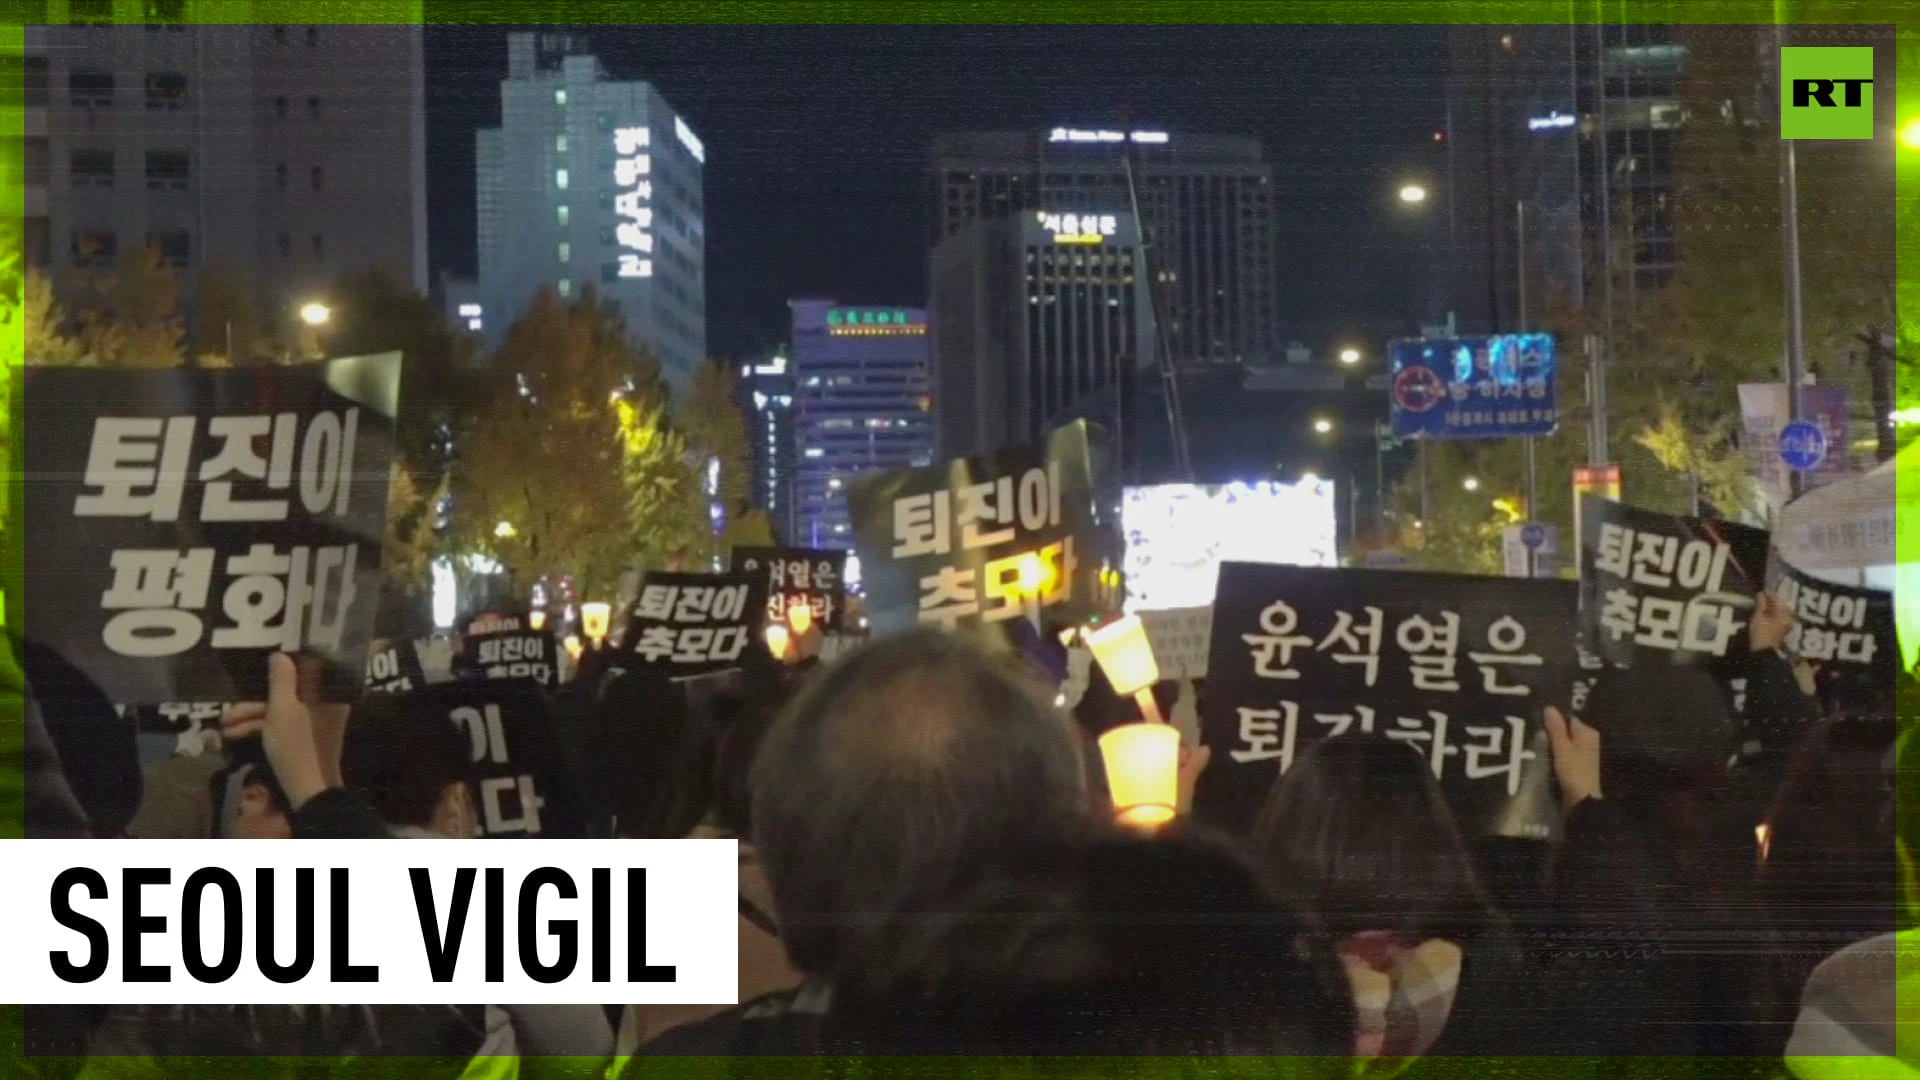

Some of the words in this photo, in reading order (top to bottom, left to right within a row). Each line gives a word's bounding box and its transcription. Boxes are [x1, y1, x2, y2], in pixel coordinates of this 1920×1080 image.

[73, 407, 358, 522] 퇴진이
[892, 461, 1061, 559] 퇴진이
[1595, 522, 1731, 594] 퇴진이
[101, 543, 357, 657] 평화다
[634, 584, 749, 622] 퇴진이
[1600, 587, 1746, 657] 추모다
[478, 637, 544, 664] 퇴진이
[634, 624, 749, 662] 추모다
[1241, 600, 1543, 696] 윤석열은
